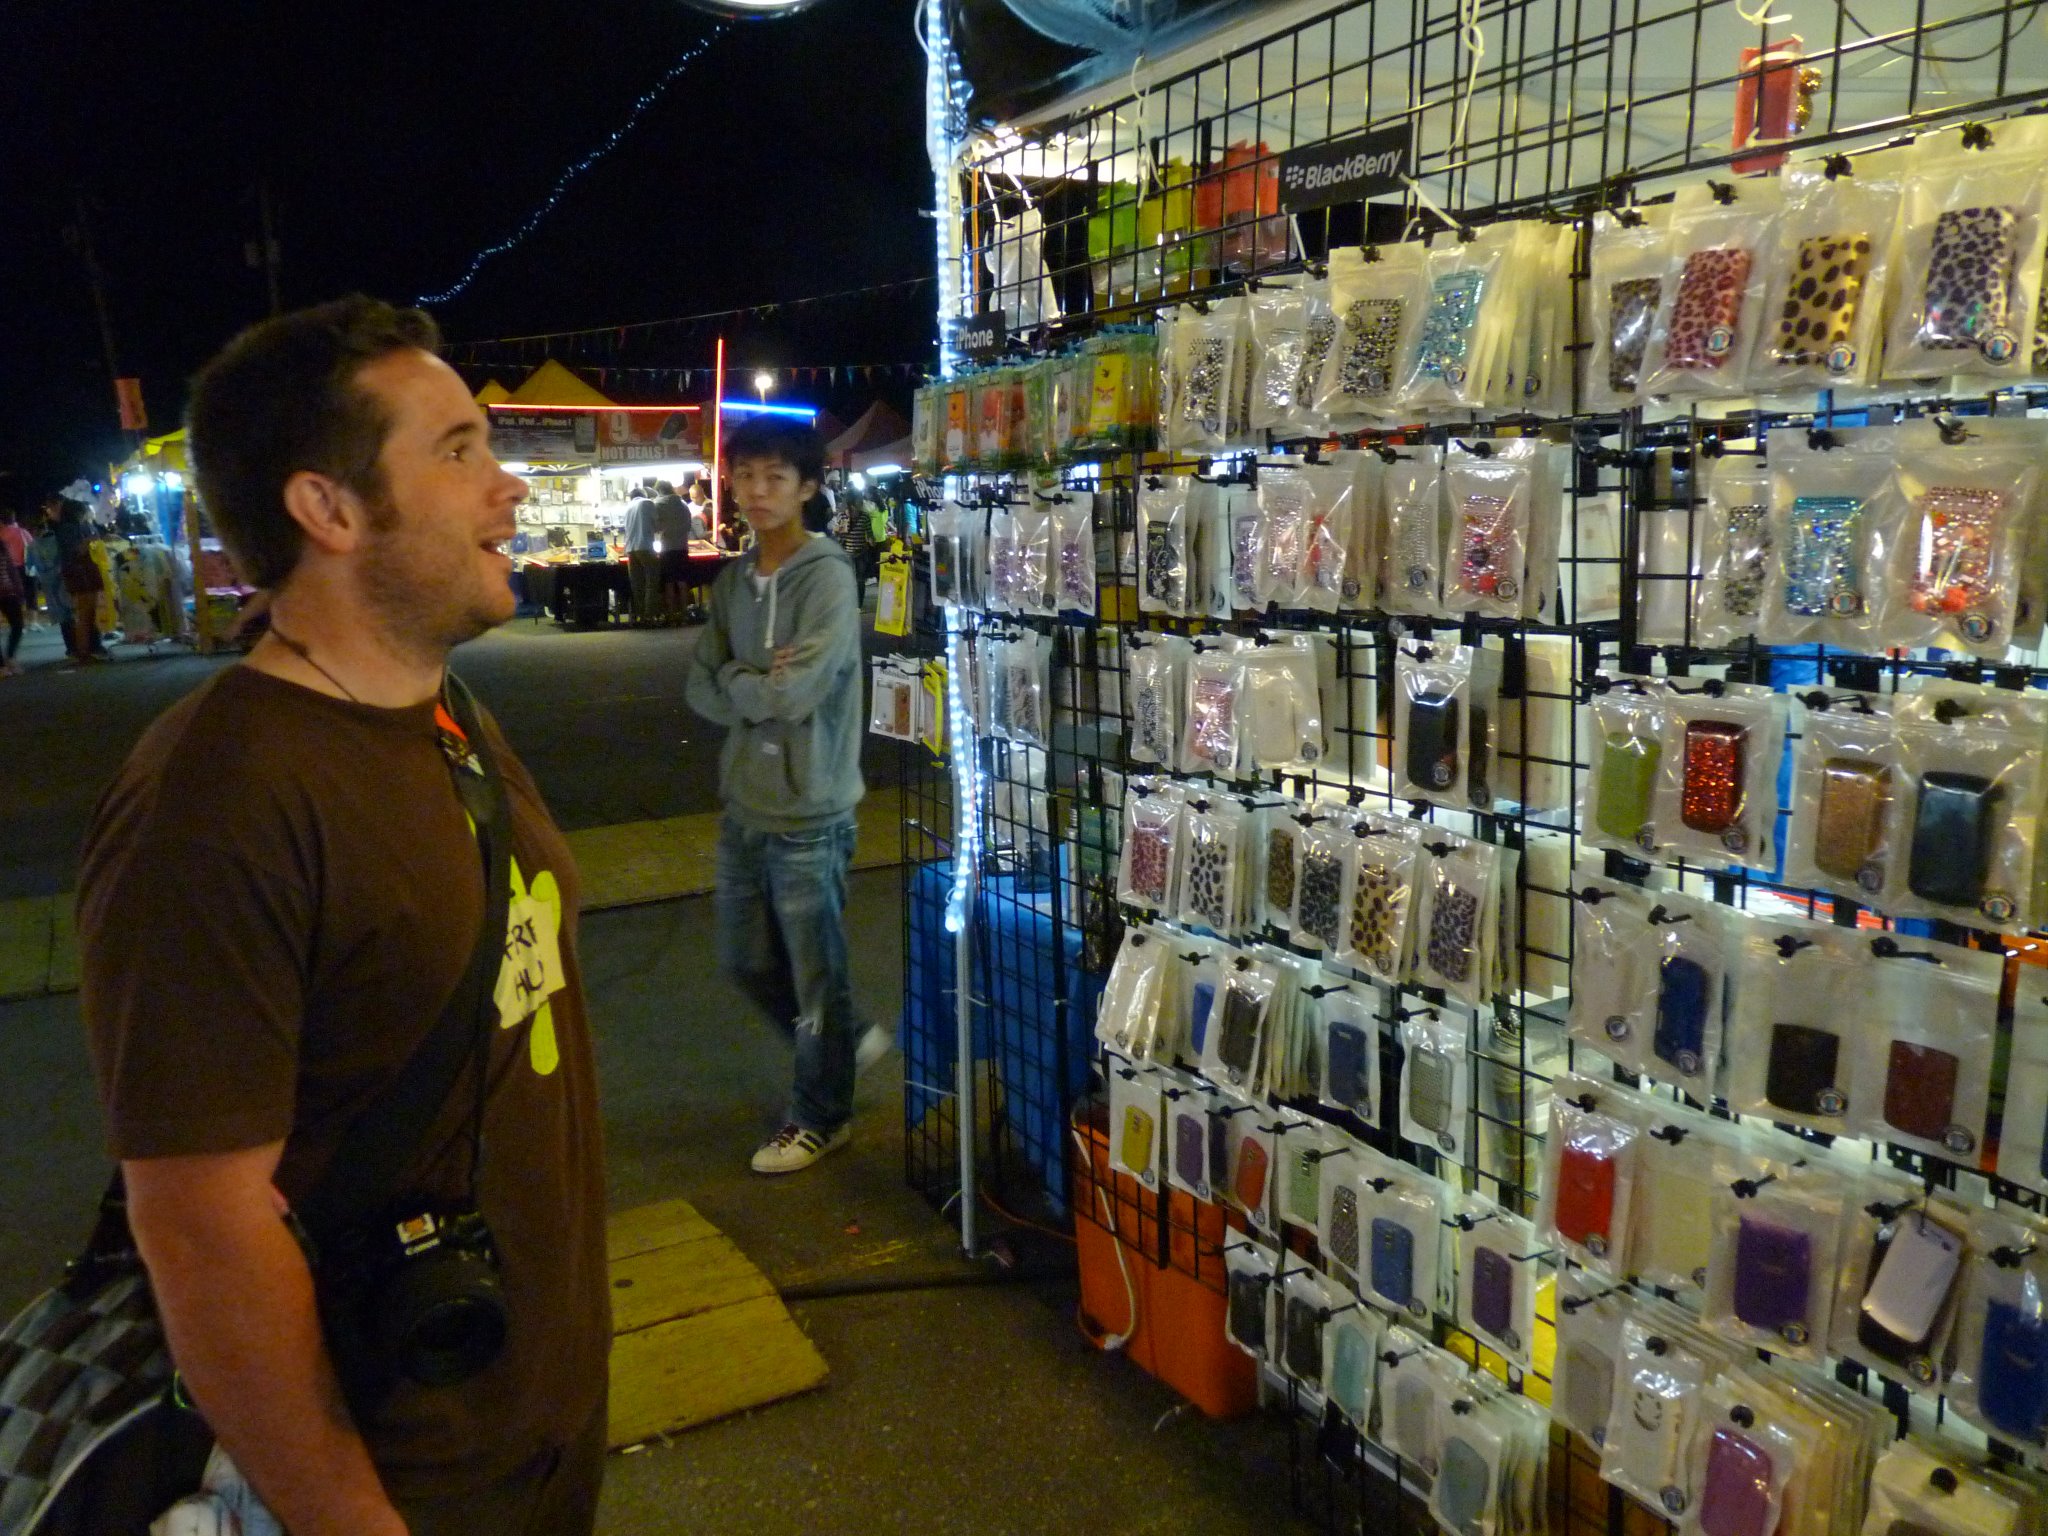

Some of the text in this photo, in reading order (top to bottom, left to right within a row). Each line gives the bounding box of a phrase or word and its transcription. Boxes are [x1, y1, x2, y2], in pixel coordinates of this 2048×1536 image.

[1305, 149, 1403, 190] BlackBerry
[956, 326, 994, 350] iPhone
[601, 446, 624, 459] HOT
